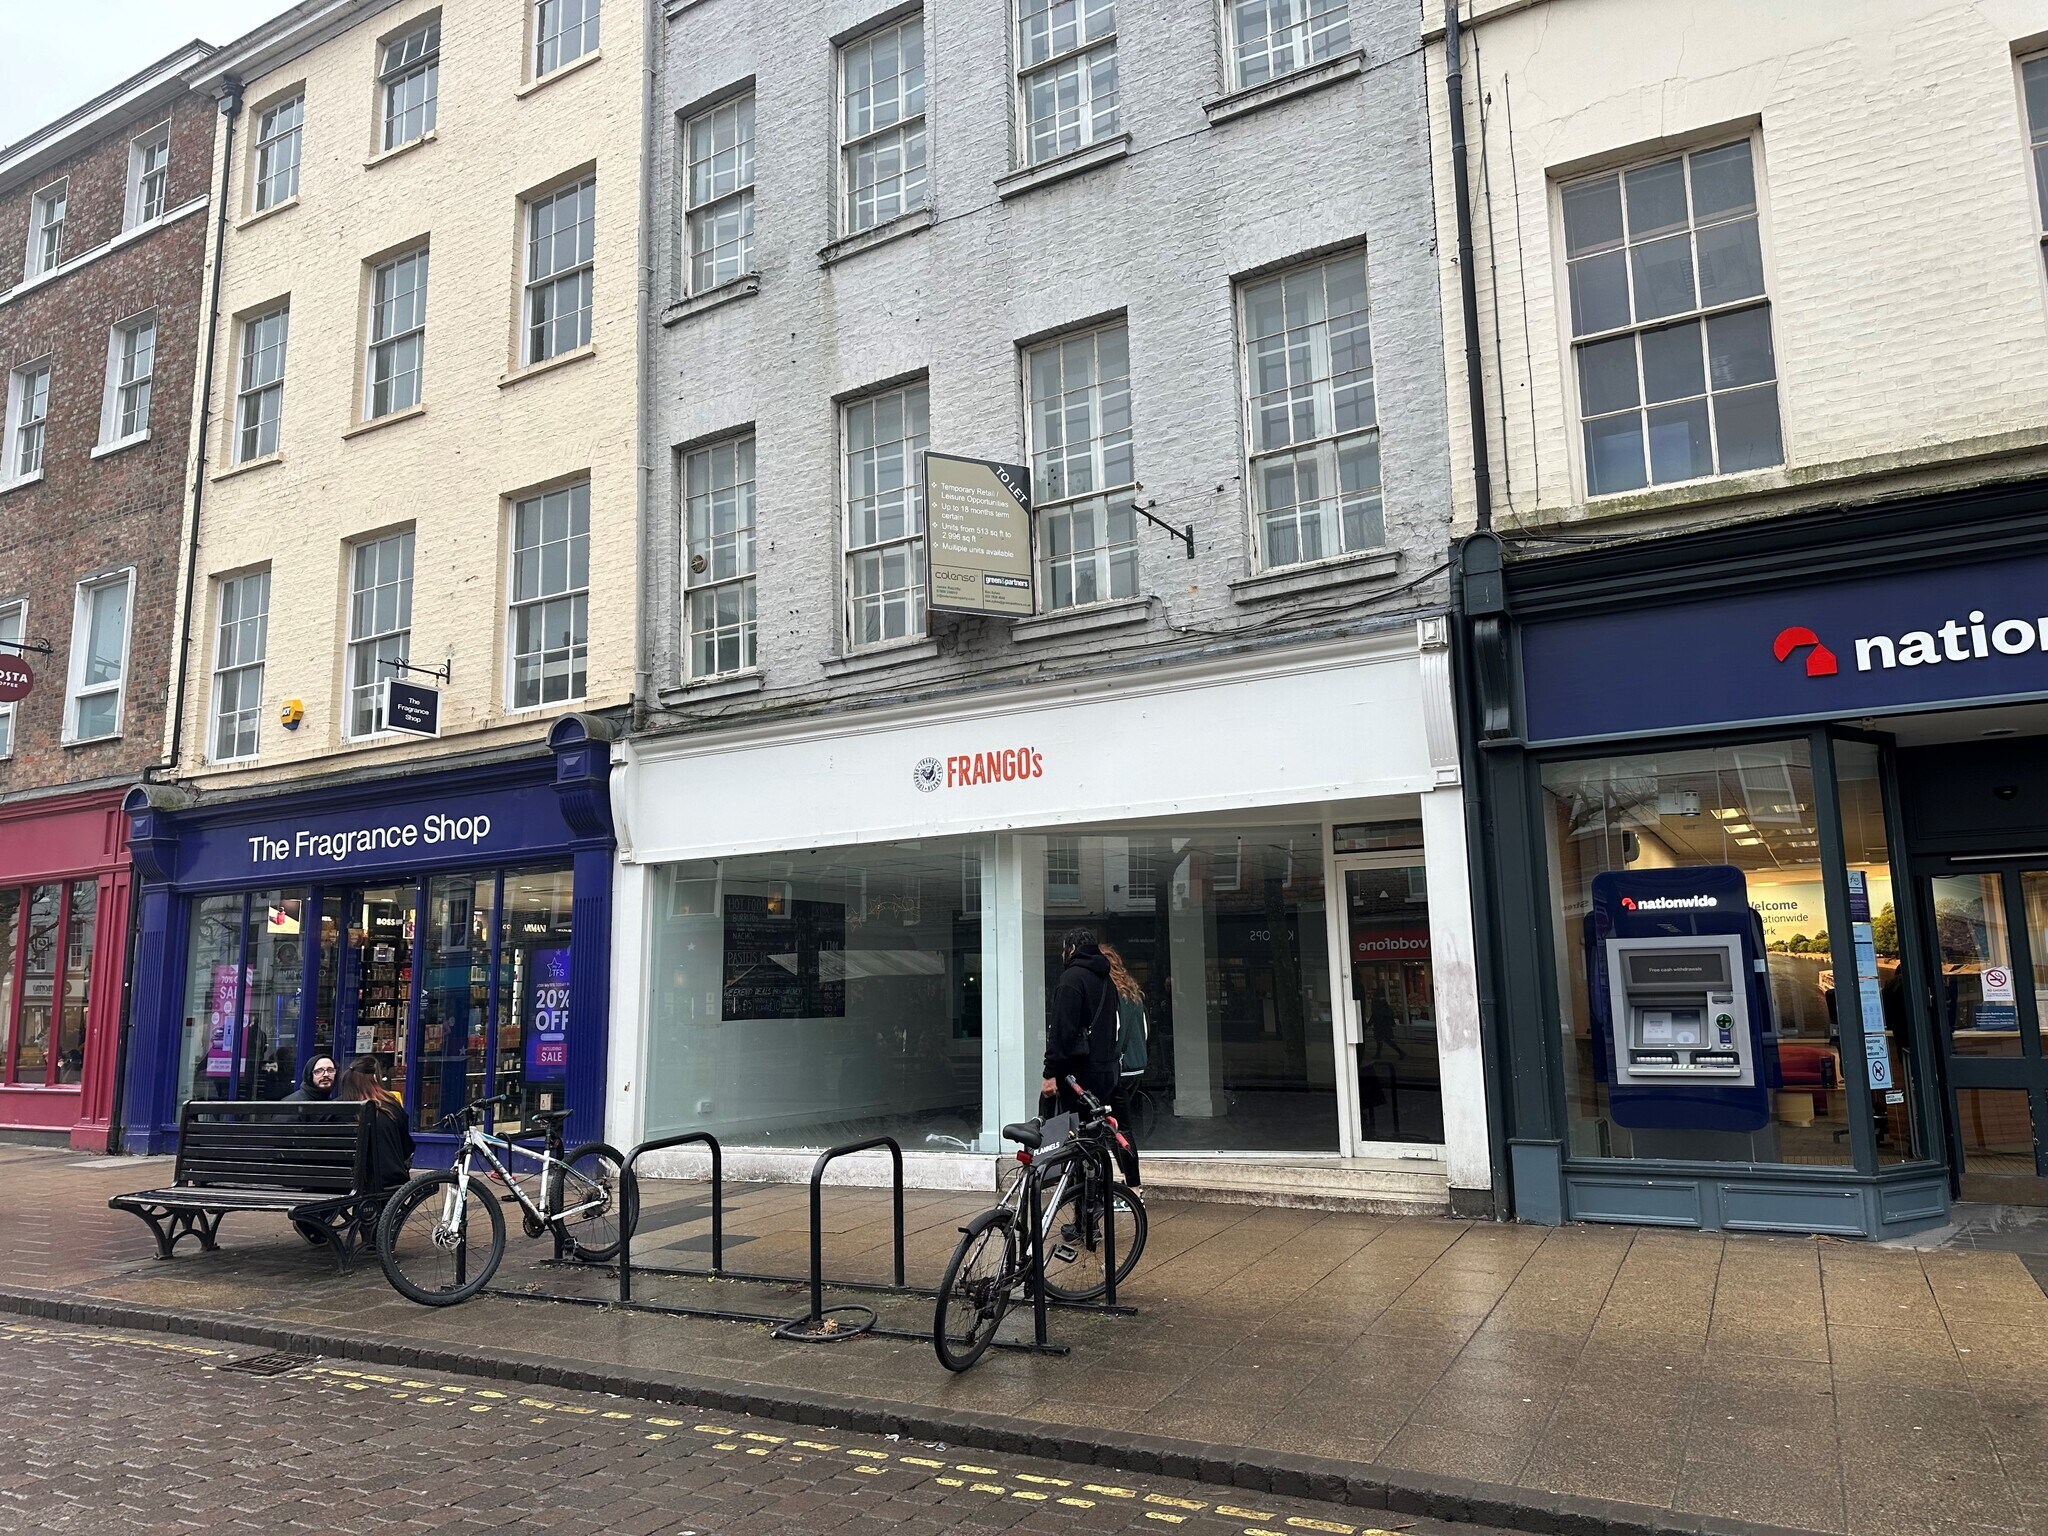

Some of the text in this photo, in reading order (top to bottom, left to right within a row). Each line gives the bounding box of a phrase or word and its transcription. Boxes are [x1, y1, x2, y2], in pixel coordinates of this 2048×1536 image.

[941, 482, 975, 496] Temporary
[976, 487, 995, 497] Retail
[996, 465, 1028, 503] TO LET
[941, 491, 1009, 508] Leisure Opportunities
[941, 502, 1010, 518] Up to 18 months term
[941, 512, 964, 521] certain
[941, 522, 959, 531] Units
[960, 524, 975, 533] from
[976, 527, 989, 535] 513
[990, 530, 999, 538] sq
[962, 535, 971, 543] sq
[942, 542, 1014, 558] Multiple units available
[935, 571, 976, 583] colenso
[1854, 610, 2048, 672] natio
[408, 697, 421, 706] The
[397, 704, 430, 716] Fragrance
[404, 714, 422, 724] Shop
[947, 746, 1043, 788] FRANGO's
[249, 813, 491, 863] The Fragrance Shop
[1638, 894, 1718, 910] nationwide
[376, 917, 396, 926] BOSS
[523, 924, 547, 933] ARMANI
[552, 968, 565, 977] TFS
[535, 989, 570, 1009] 20%
[535, 1010, 569, 1031] OFF
[541, 1051, 562, 1062] SALE
[1033, 1141, 1060, 1157] FLANNELS
